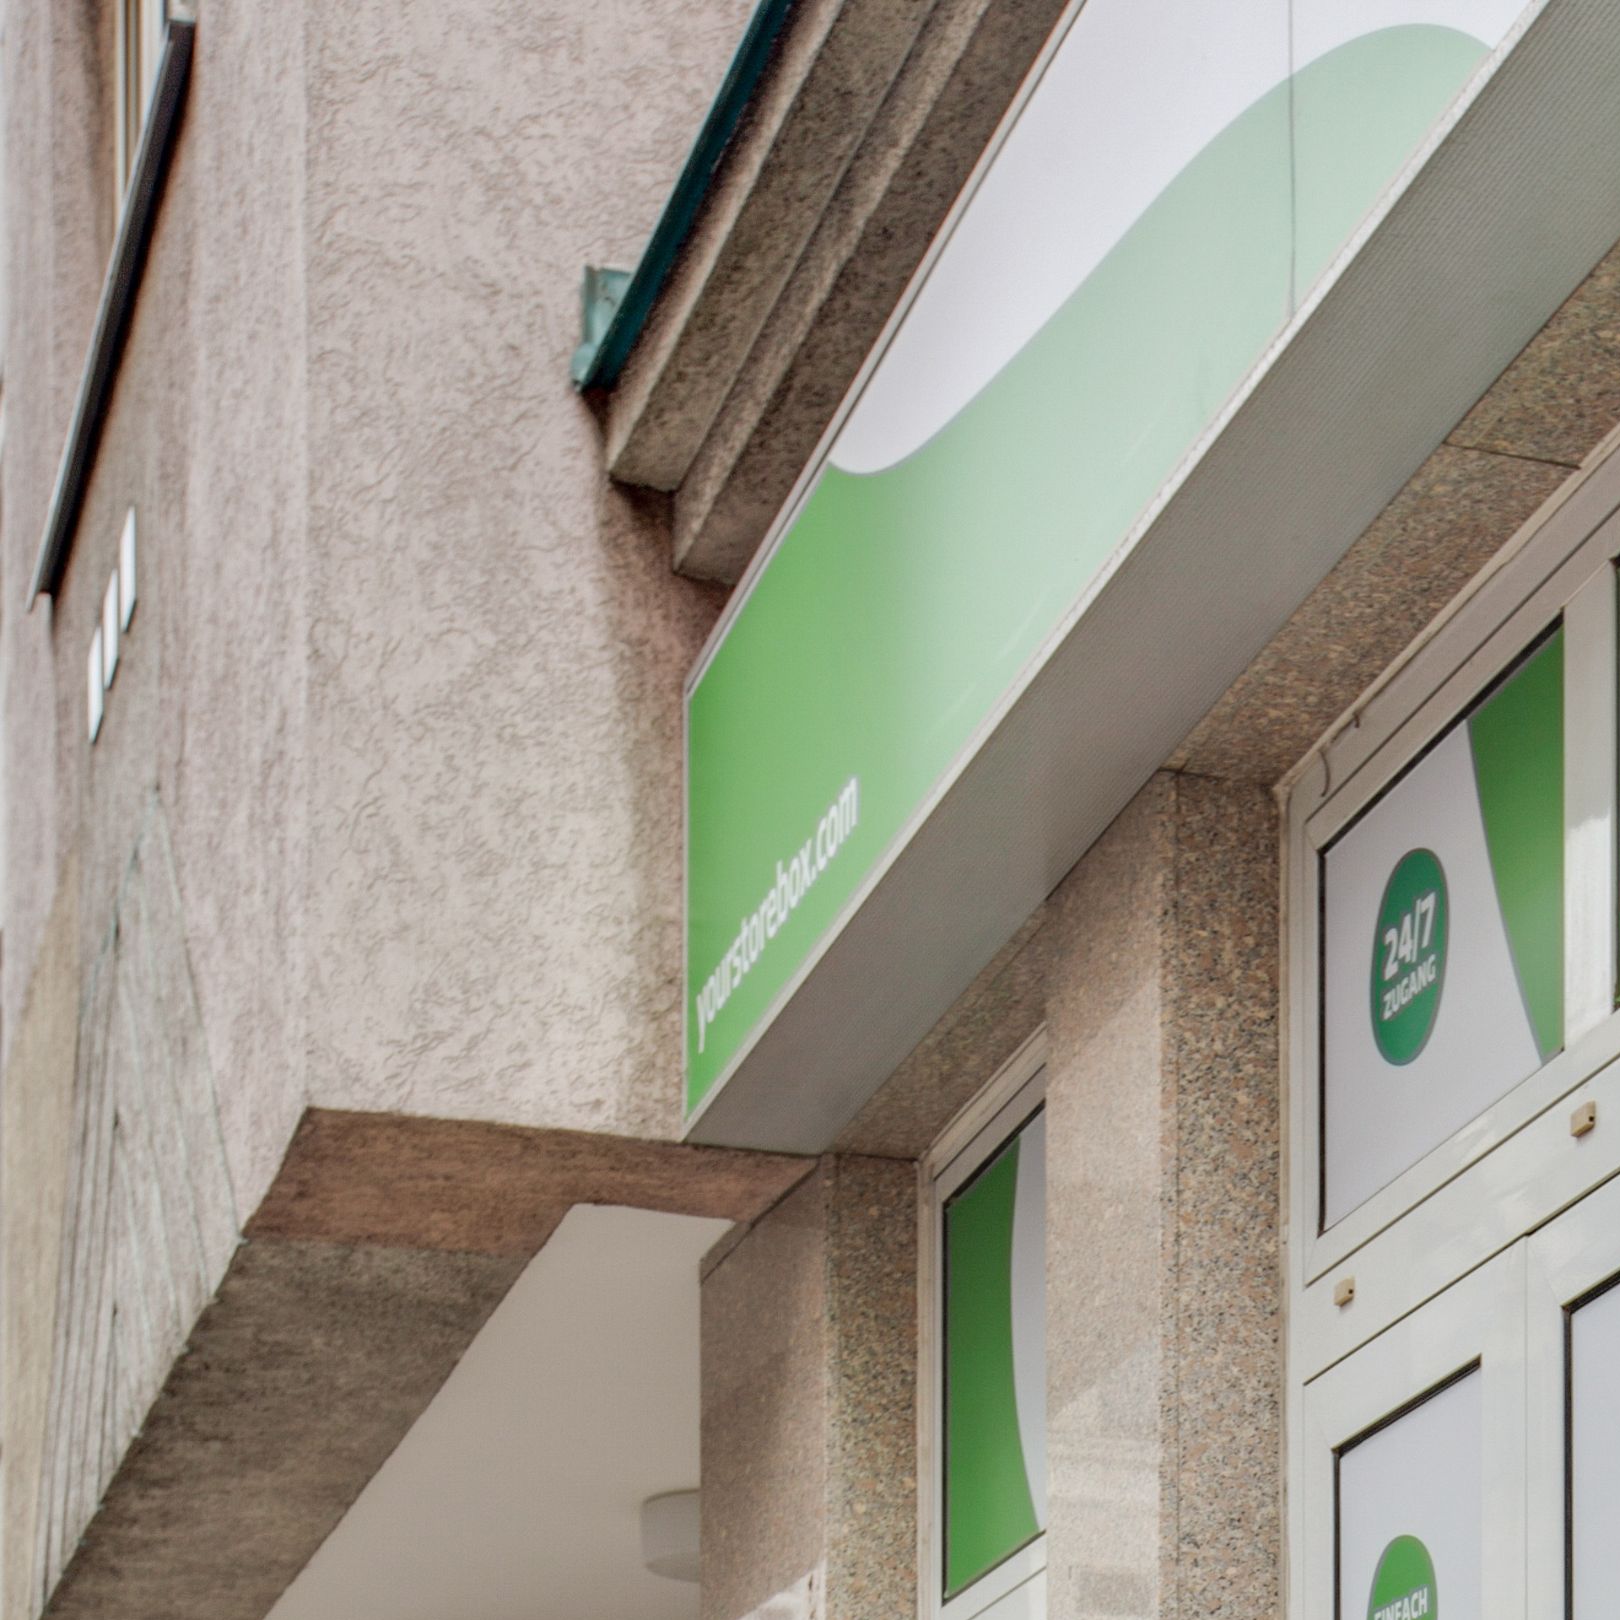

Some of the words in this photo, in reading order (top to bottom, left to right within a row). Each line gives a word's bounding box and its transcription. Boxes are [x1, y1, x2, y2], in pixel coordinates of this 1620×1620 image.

[696, 776, 858, 1054] yourstorebox.com
[1384, 891, 1437, 981] 24/7
[1382, 953, 1437, 1020] ZUGANG
